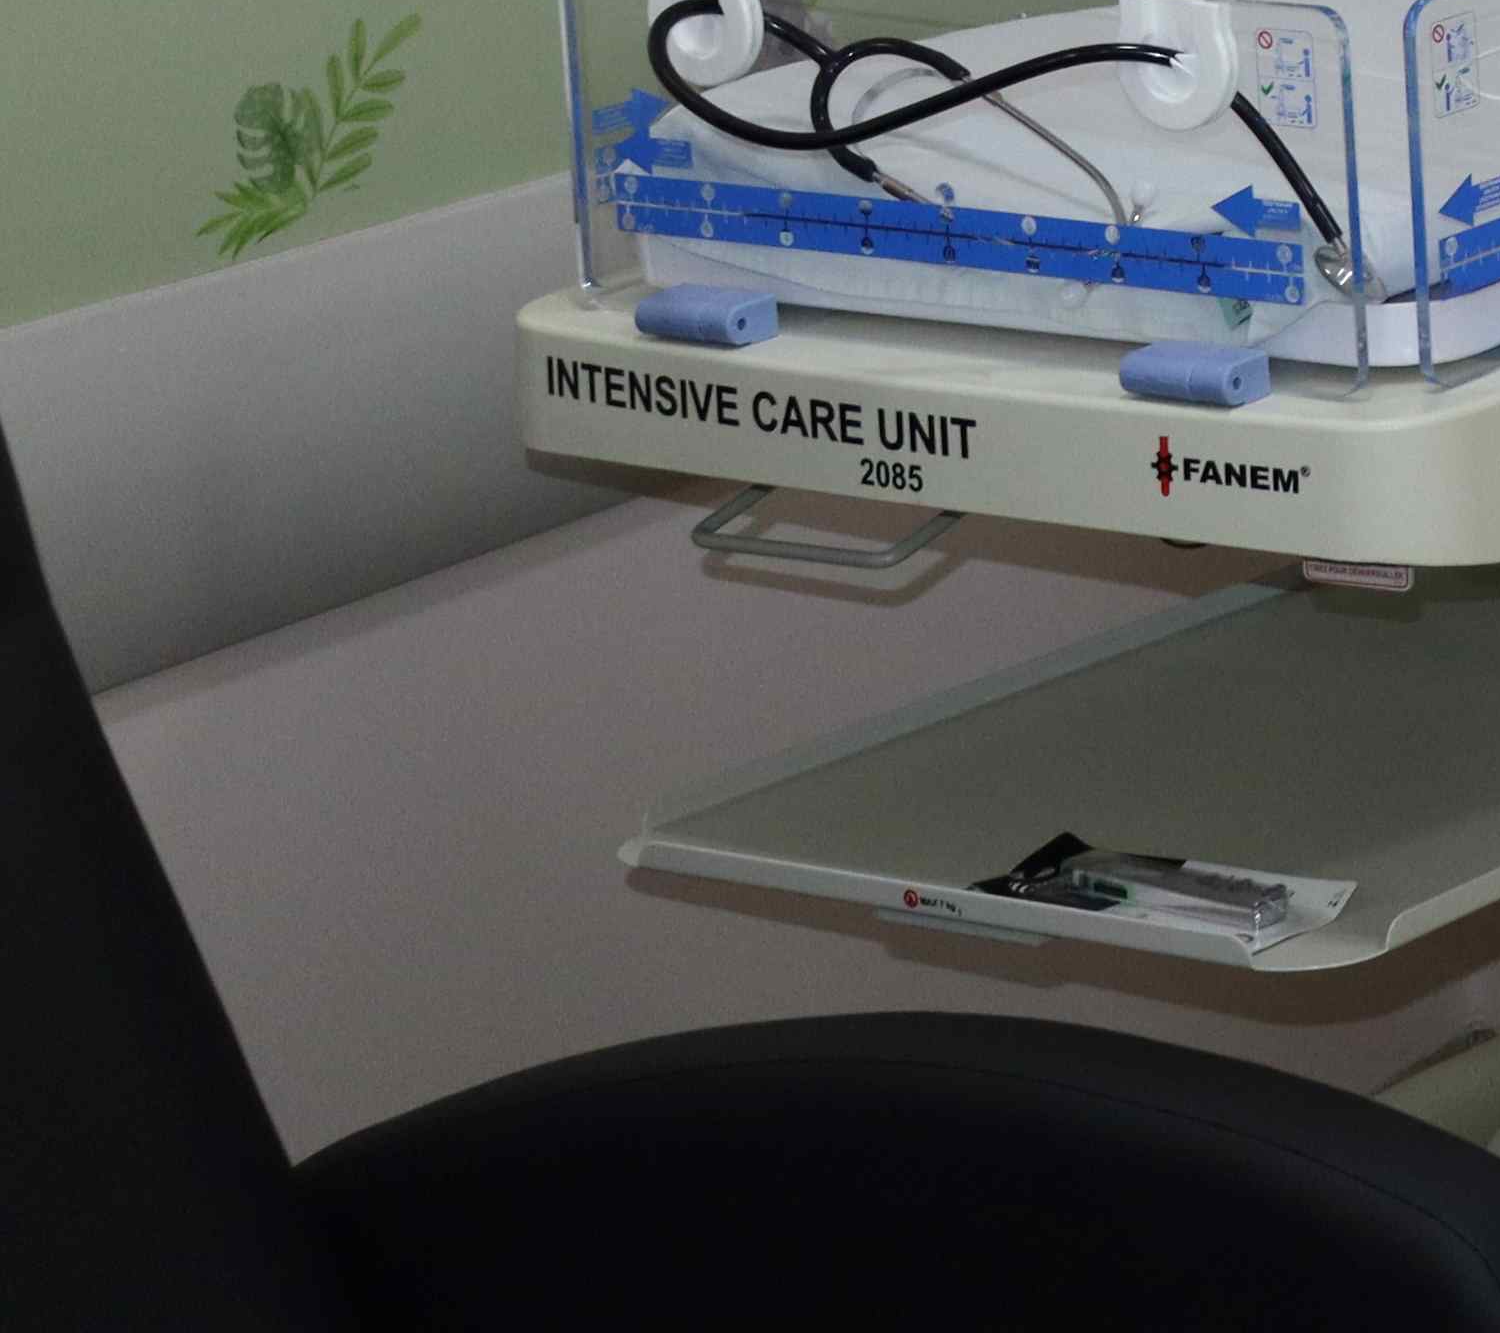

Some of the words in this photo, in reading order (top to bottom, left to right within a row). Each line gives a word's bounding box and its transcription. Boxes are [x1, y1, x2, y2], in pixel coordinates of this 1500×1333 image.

[546, 356, 740, 427] INTENSIVE
[752, 391, 864, 445] CARE
[877, 408, 976, 459] UNIT
[859, 458, 923, 492] 2085
